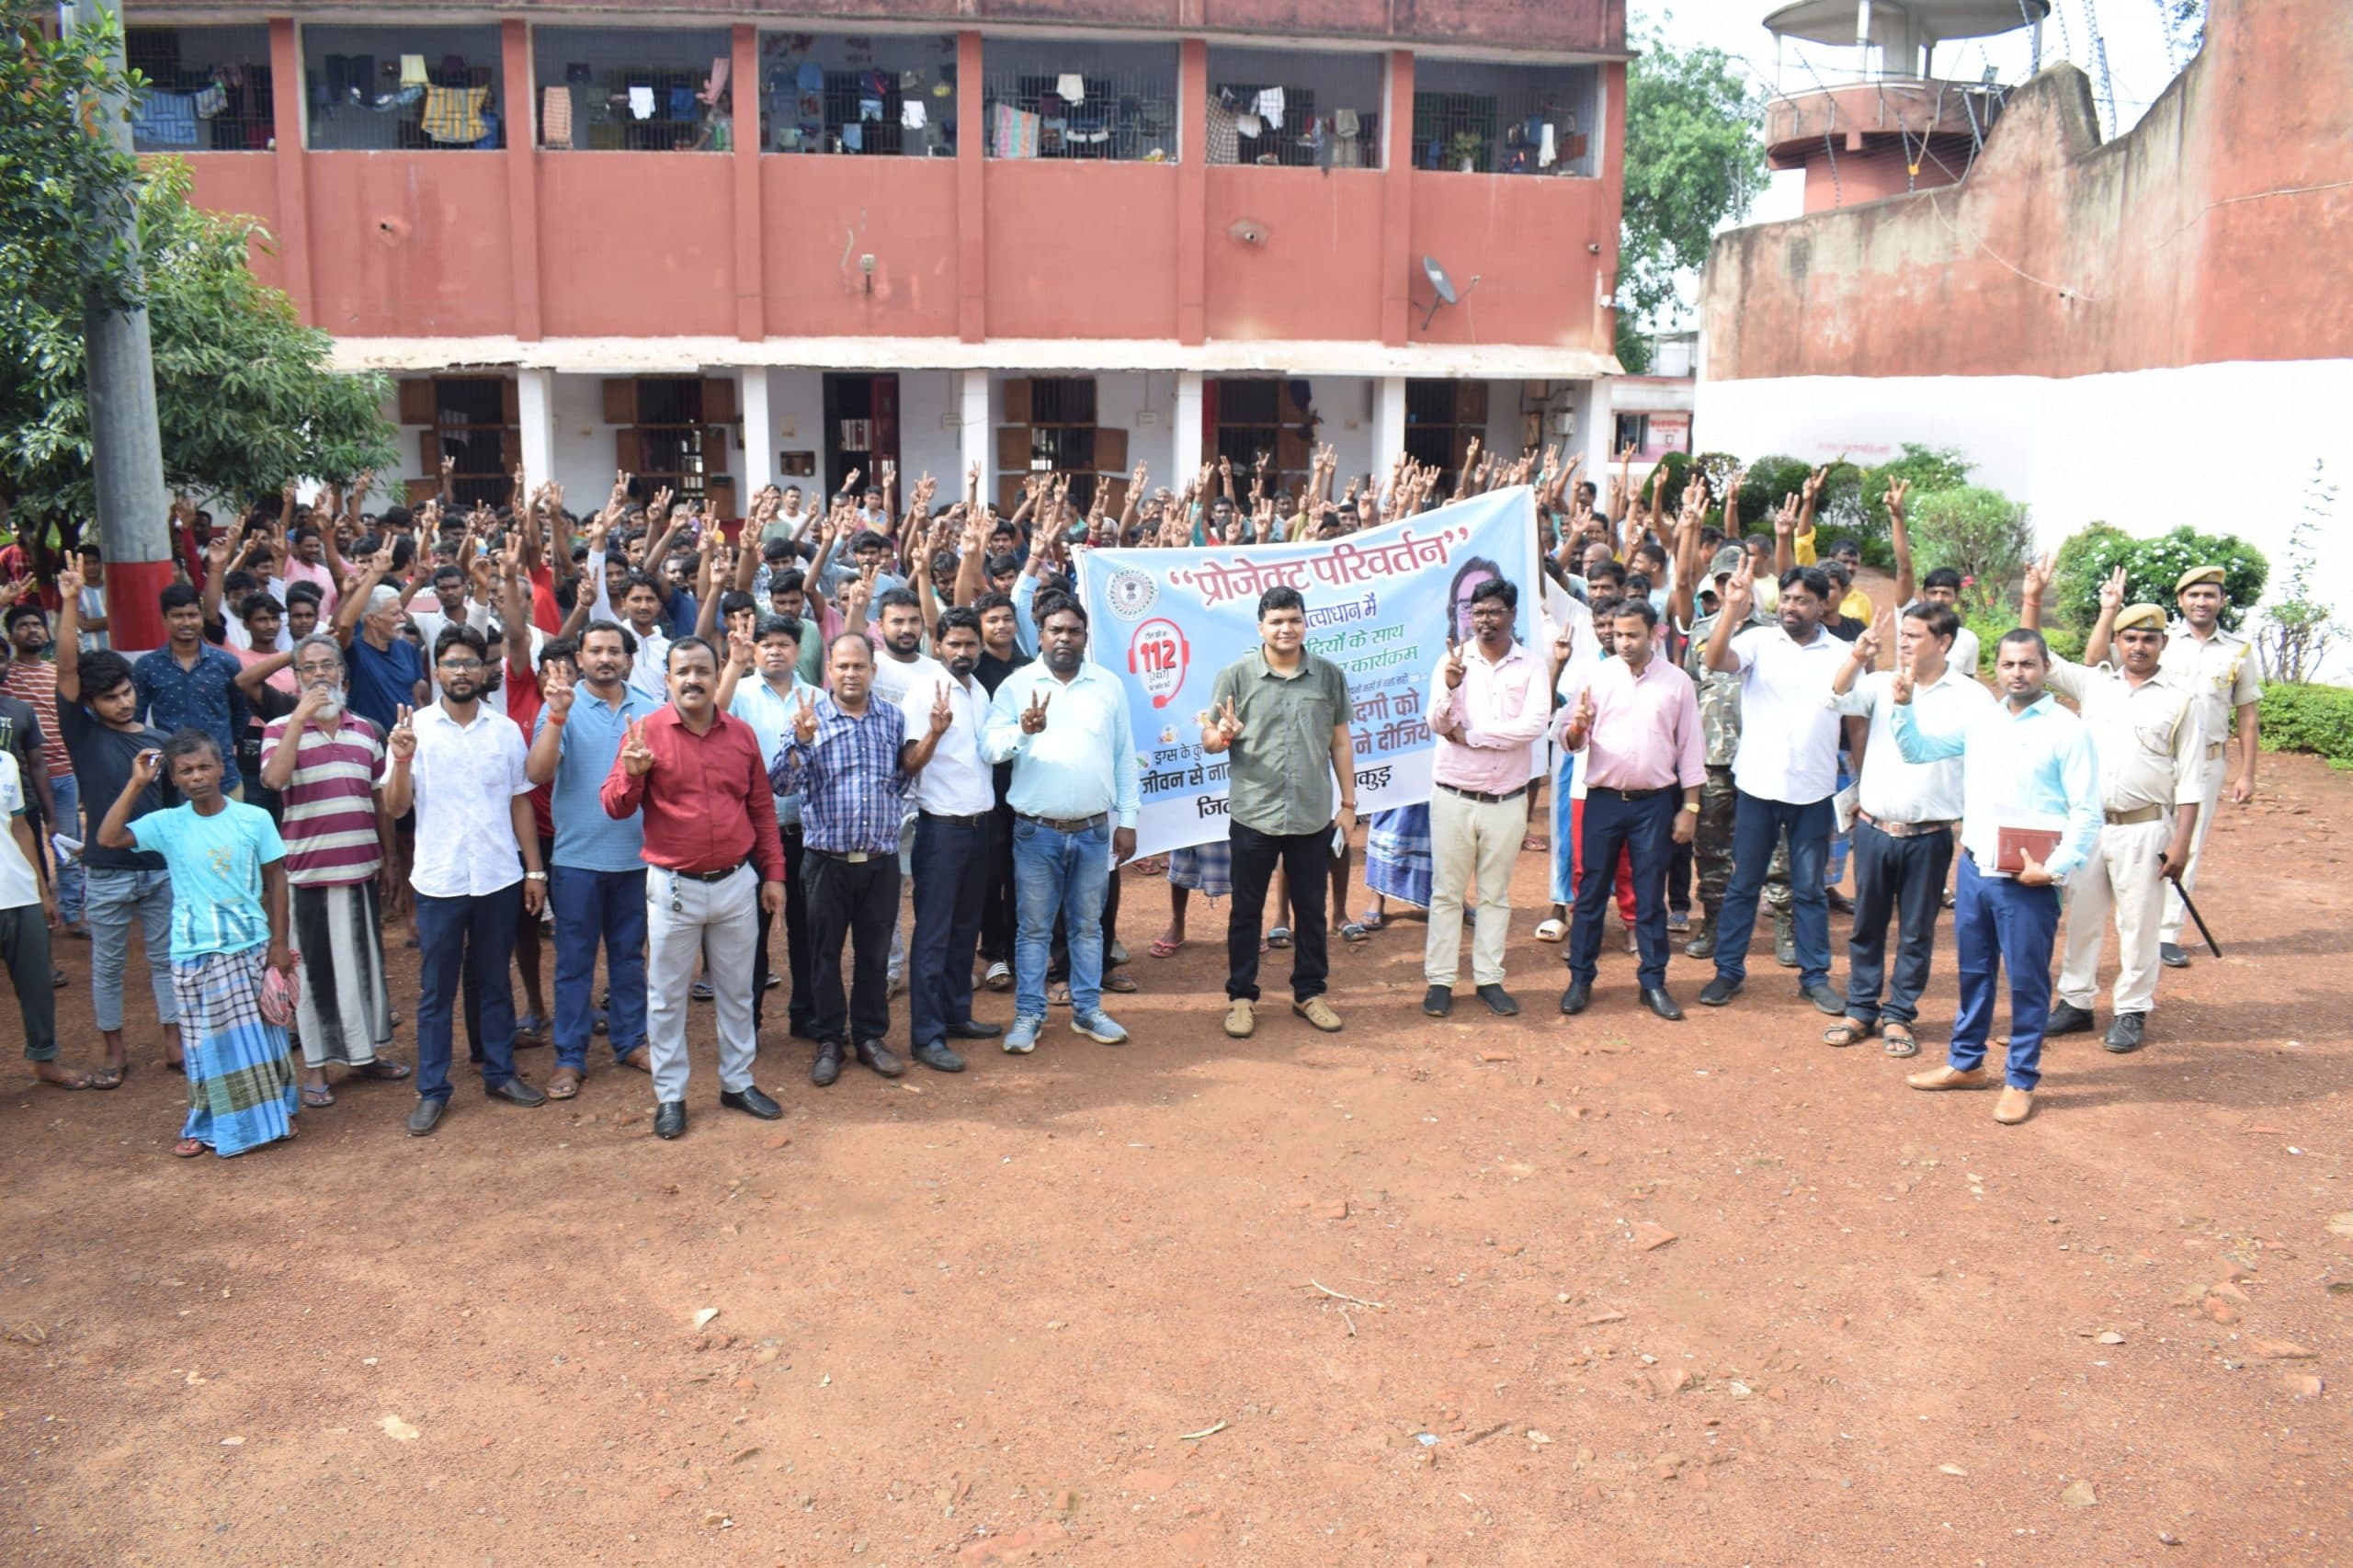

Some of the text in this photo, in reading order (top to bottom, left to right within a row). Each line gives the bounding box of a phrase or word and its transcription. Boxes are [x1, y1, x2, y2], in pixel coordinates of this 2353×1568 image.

[1349, 630, 1368, 648] के
[1371, 624, 1405, 644] साथ
[1140, 639, 1177, 673] 112
[1392, 687, 1420, 716] को
[1180, 743, 1191, 759] के
[1140, 761, 1230, 795] जीवन से ना
